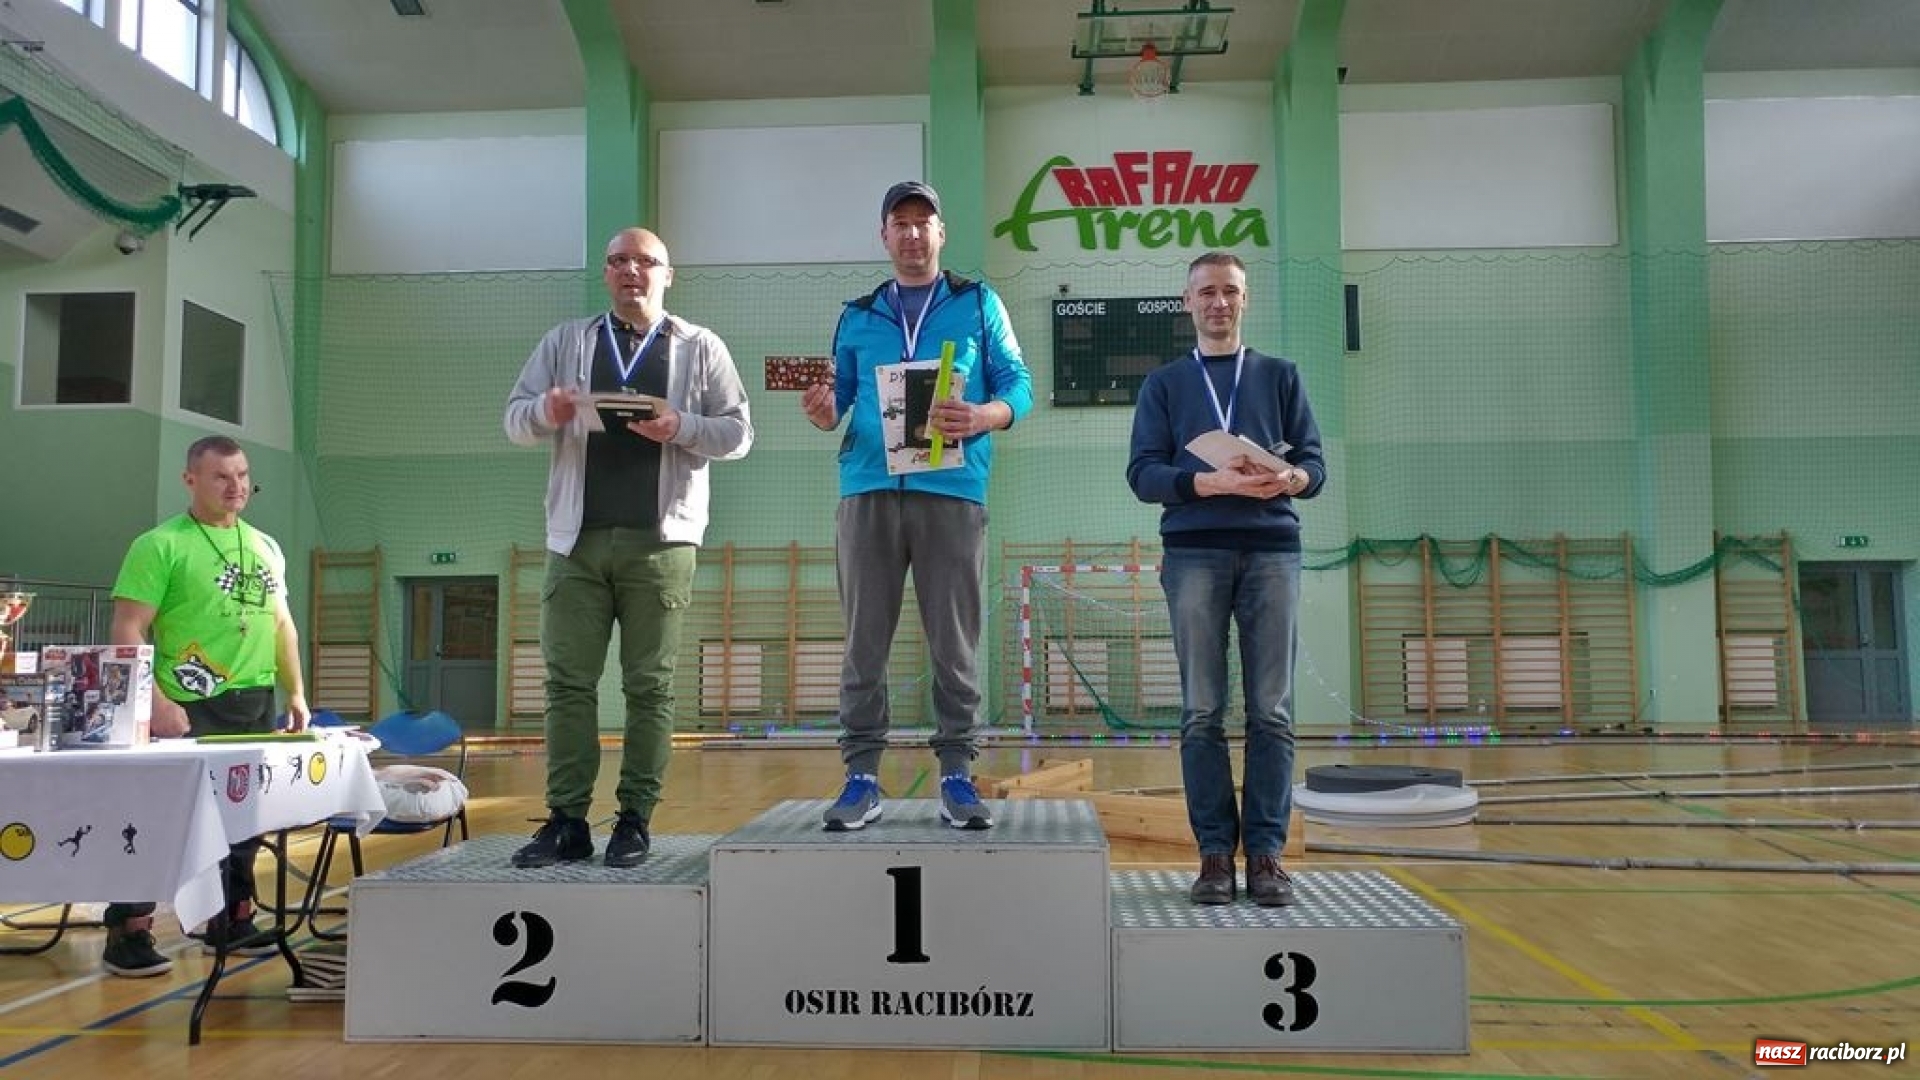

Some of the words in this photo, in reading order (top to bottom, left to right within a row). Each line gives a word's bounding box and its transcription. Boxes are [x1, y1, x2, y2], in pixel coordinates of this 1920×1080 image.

[993, 155, 1270, 251] Arena
[1056, 301, 1106, 316] GOŚCIE
[886, 865, 931, 964] 1
[491, 910, 557, 1008] 2
[785, 989, 861, 1015] OSIR
[871, 985, 1034, 1017] RACIBÓRZ
[1262, 952, 1319, 1032] 3
